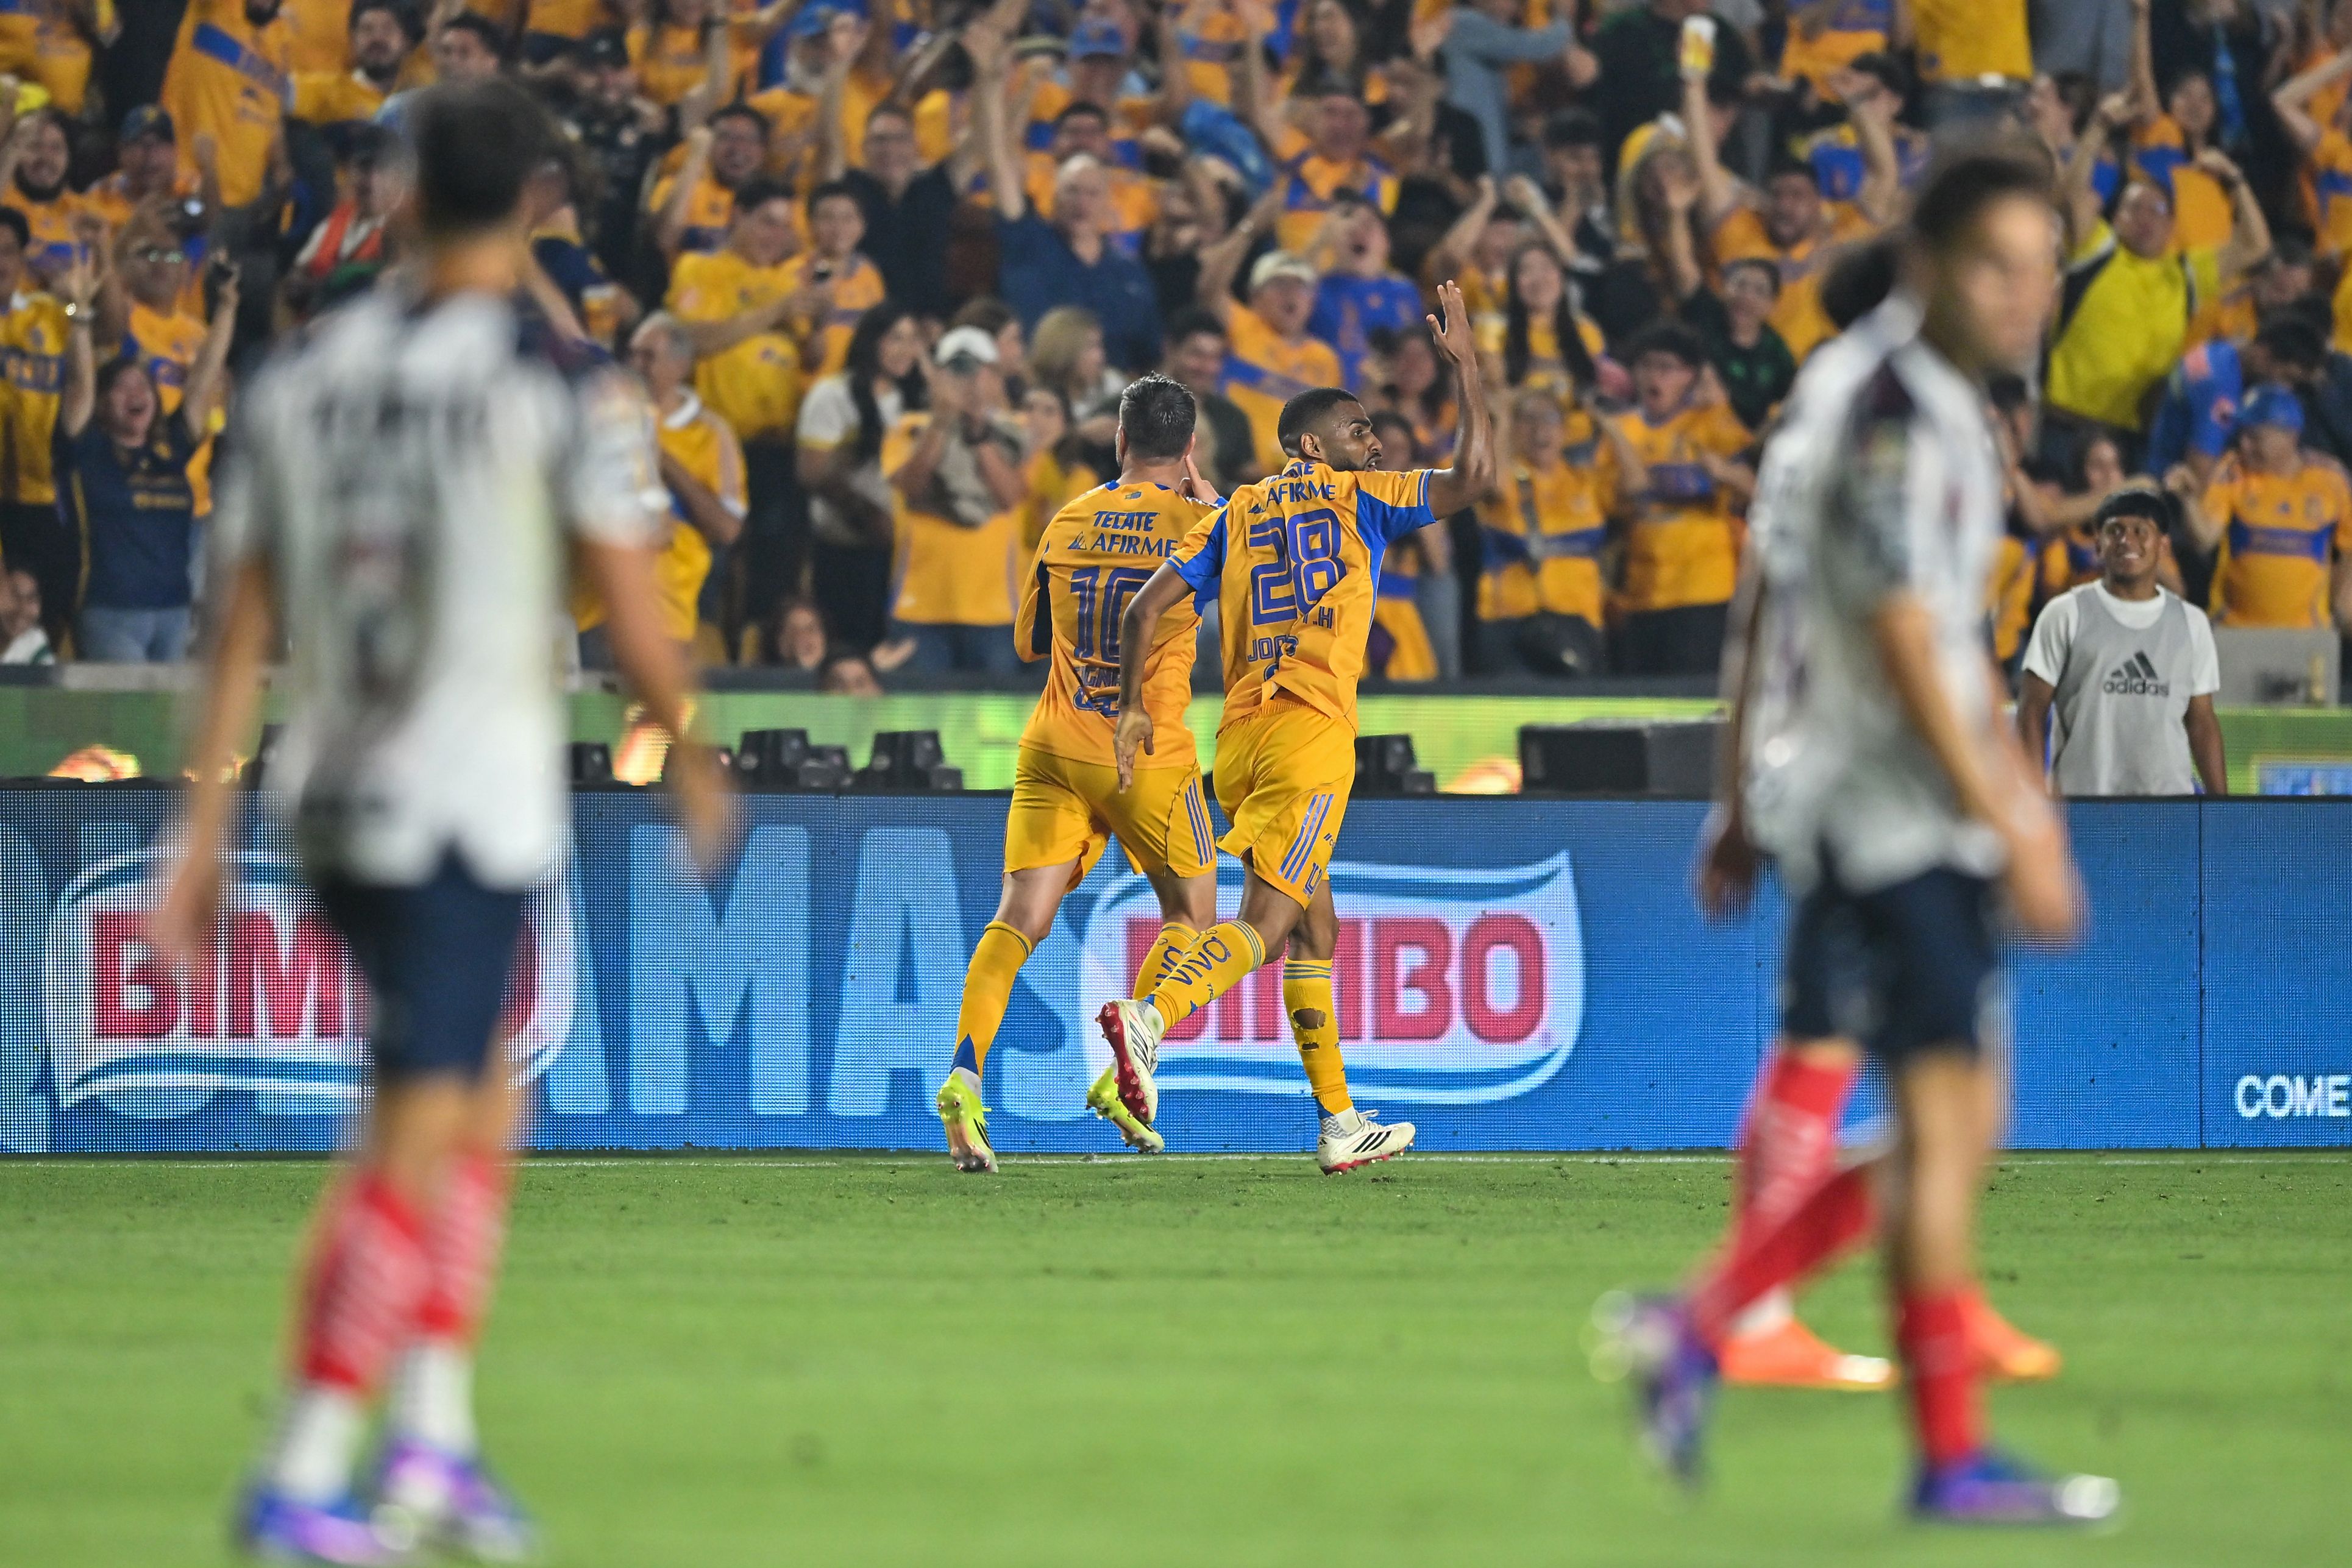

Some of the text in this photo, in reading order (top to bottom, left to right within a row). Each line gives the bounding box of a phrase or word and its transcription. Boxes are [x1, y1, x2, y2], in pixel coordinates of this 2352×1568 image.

[1267, 480, 1336, 508] AFIRME
[1093, 511, 1160, 532] TECATE
[1090, 533, 1178, 558] AFIRME
[1248, 508, 1348, 626] 28
[2103, 678, 2169, 698] adidas
[1166, 935, 1232, 985] viva
[2236, 1074, 2351, 1118] COME
